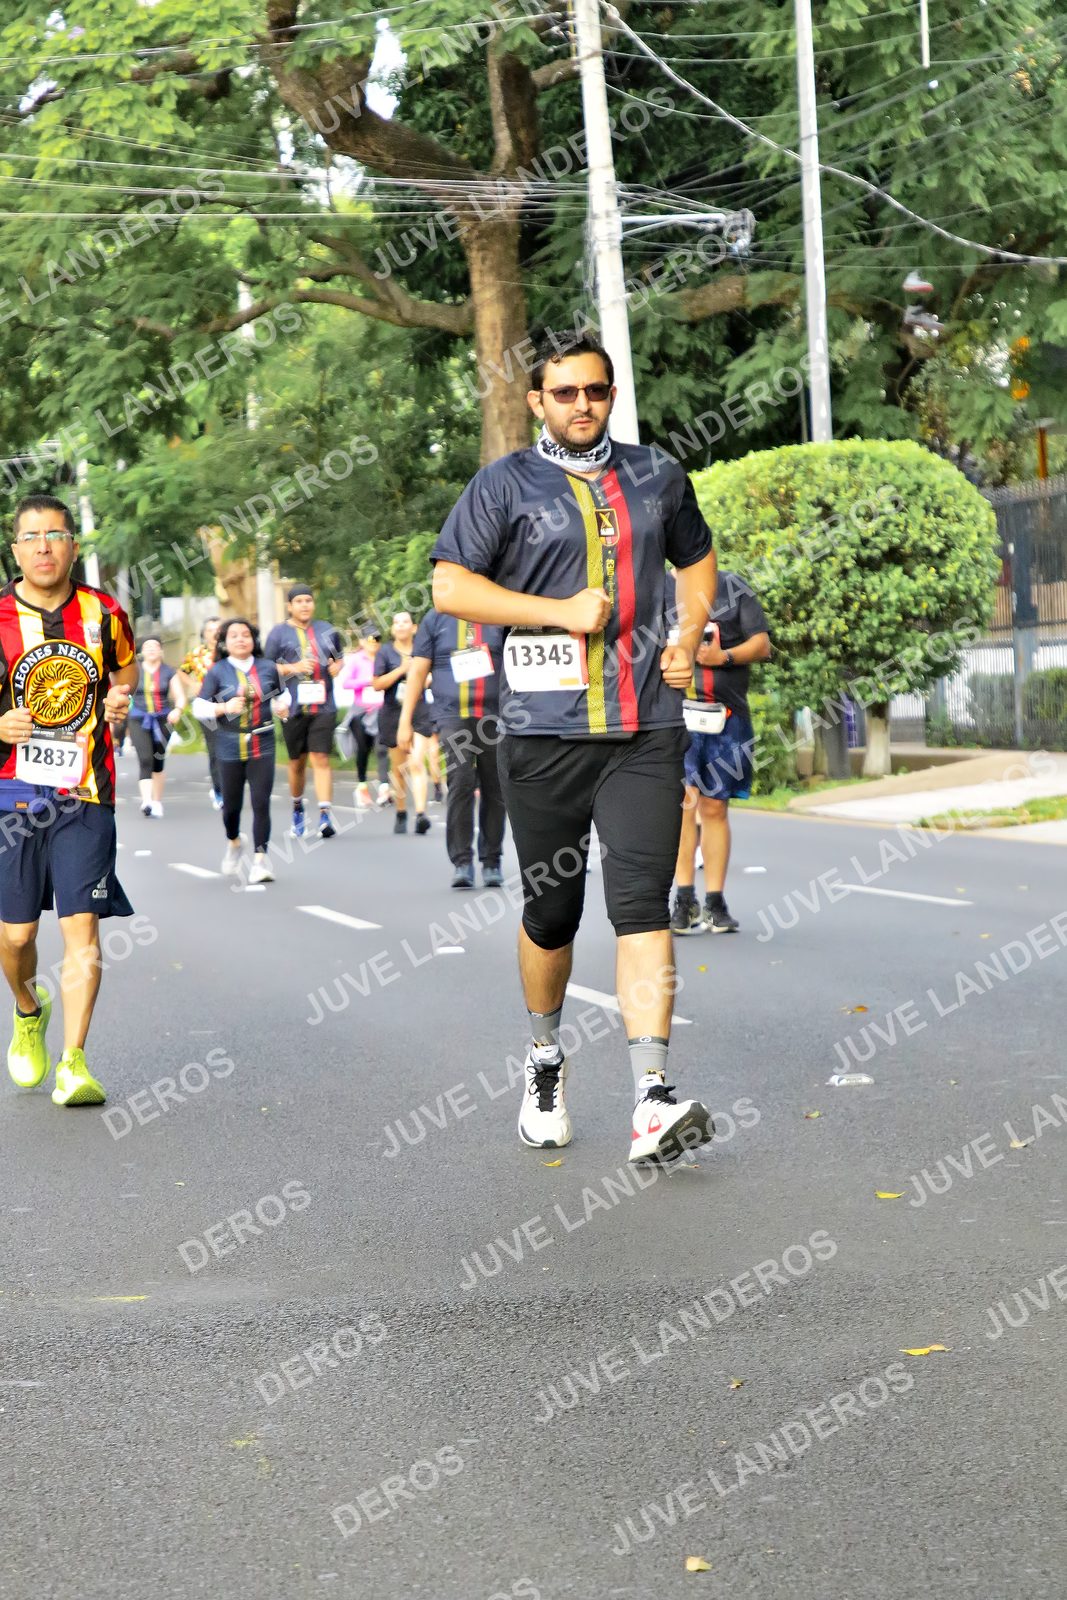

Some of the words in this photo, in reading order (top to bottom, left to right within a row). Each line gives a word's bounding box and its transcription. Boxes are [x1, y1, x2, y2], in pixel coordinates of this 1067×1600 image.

[15, 645, 52, 689] LEONES
[507, 643, 574, 667] 13345
[58, 693, 94, 731] UADALAJARA
[21, 744, 78, 768] 12837
